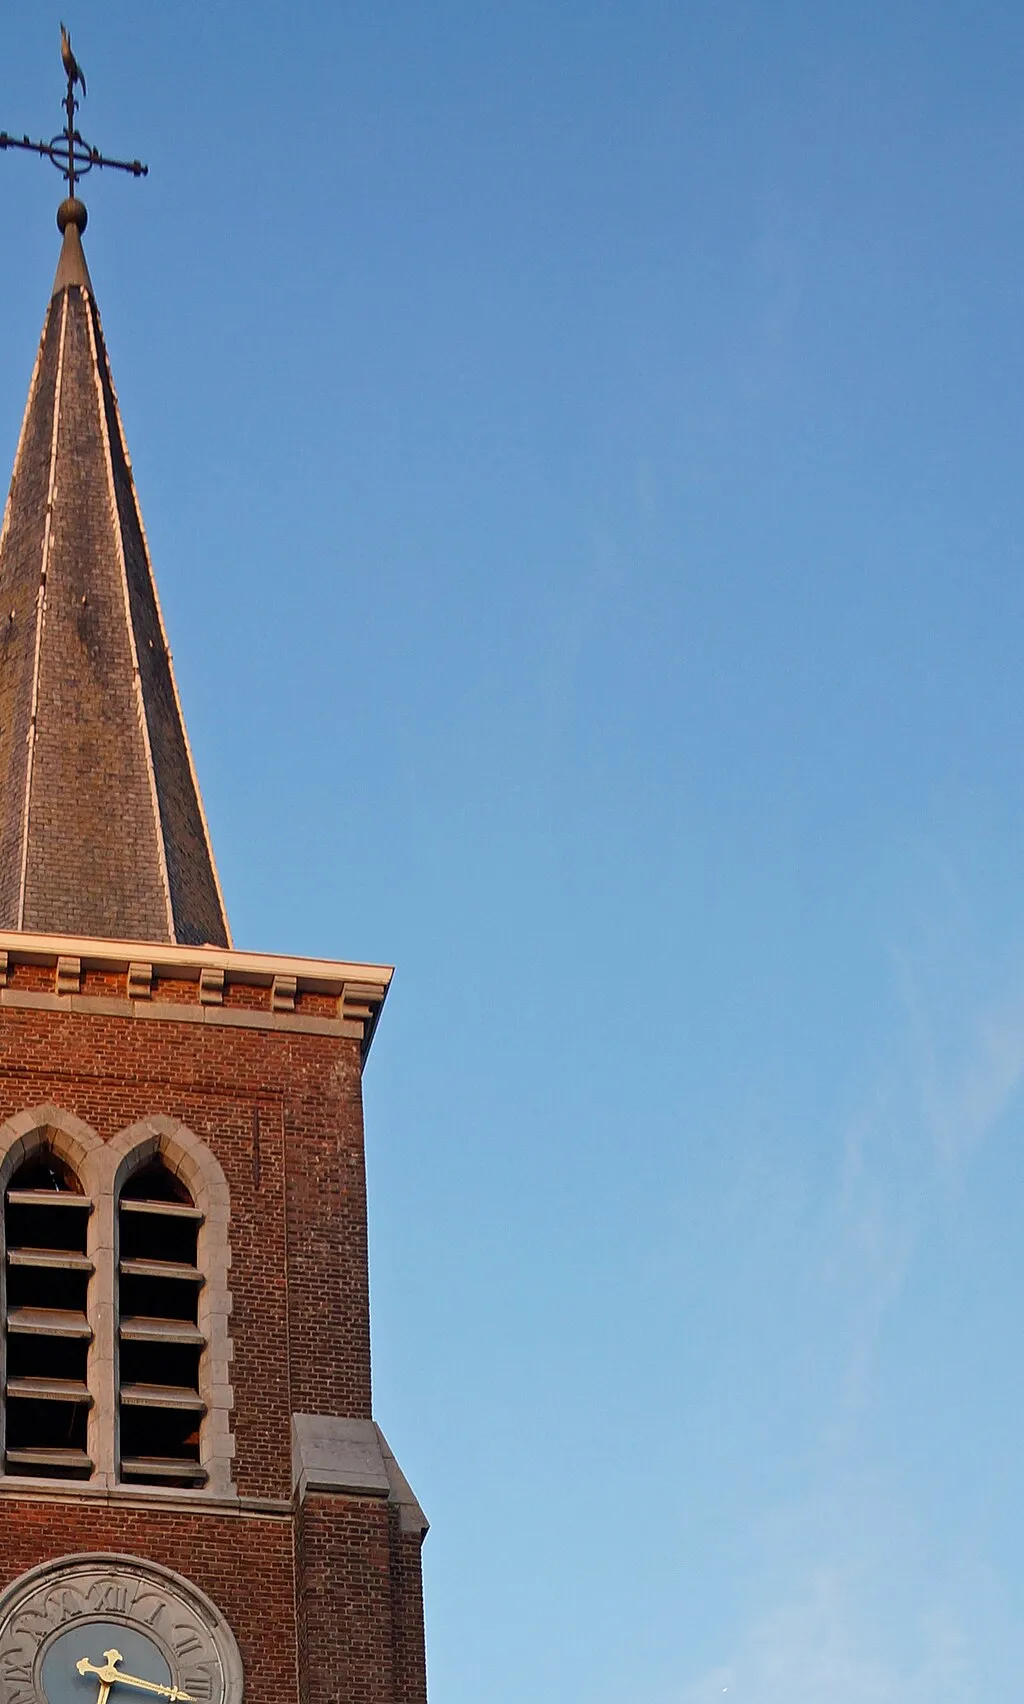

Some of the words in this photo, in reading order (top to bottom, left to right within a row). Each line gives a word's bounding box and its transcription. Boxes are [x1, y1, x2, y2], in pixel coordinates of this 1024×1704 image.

[92, 1585, 127, 1612] XII
[143, 1602, 166, 1626] I
[172, 1635, 204, 1658] II
[2, 1660, 32, 1684] IX
[184, 1675, 212, 1700] III
